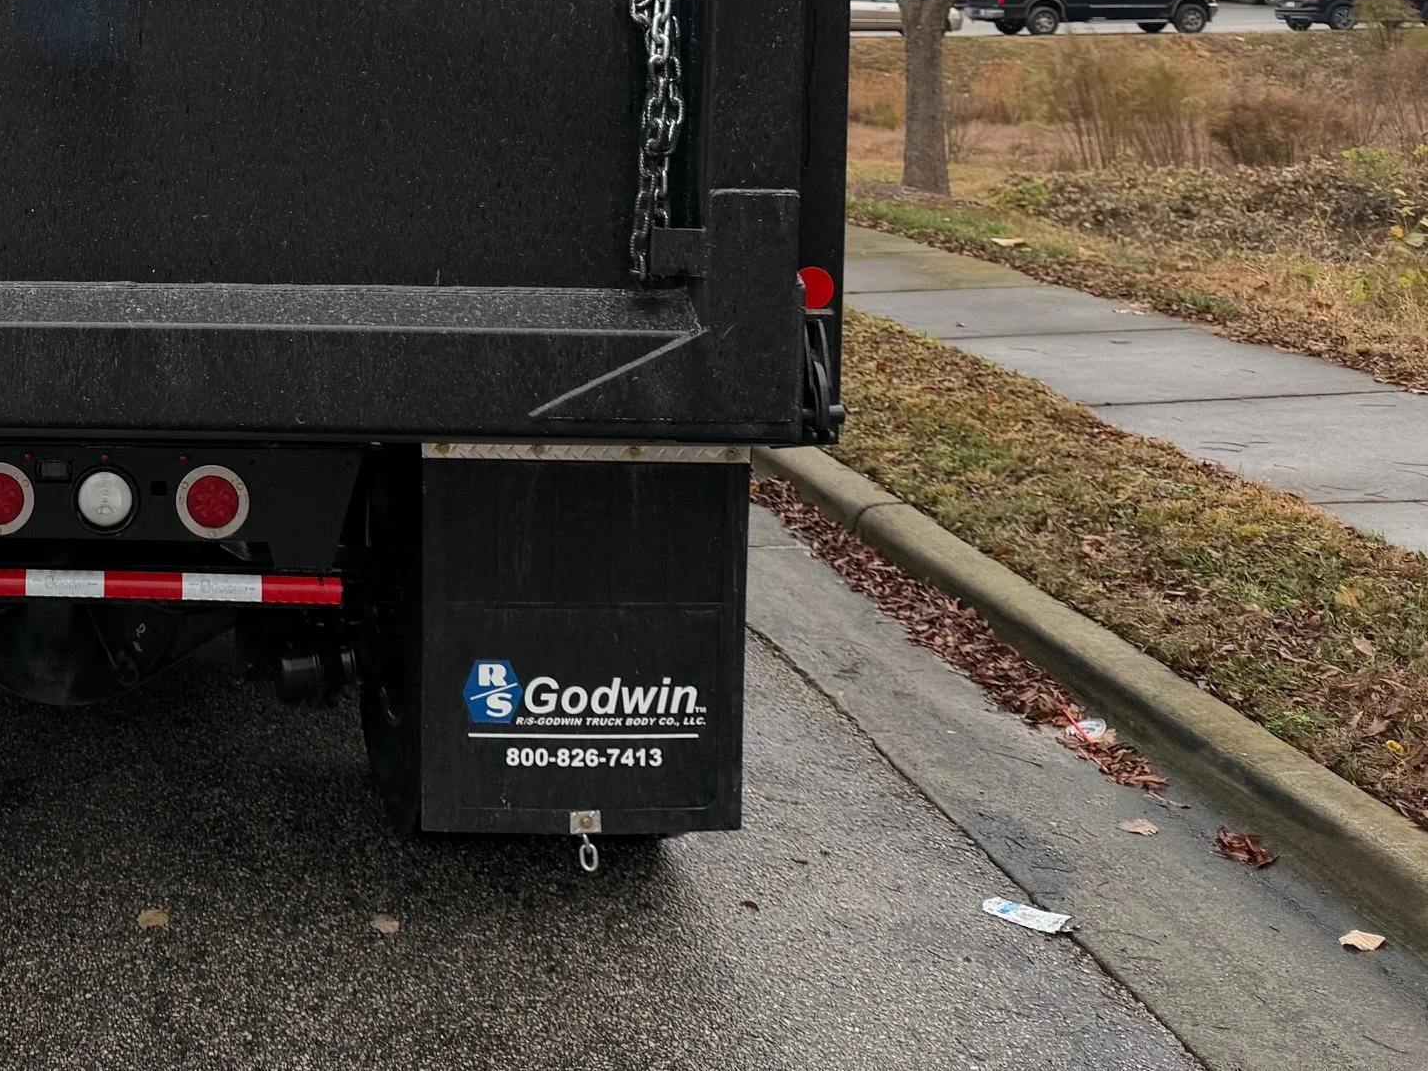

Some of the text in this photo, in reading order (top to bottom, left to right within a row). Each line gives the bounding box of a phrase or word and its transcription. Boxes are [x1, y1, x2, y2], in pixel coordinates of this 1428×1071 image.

[524, 676, 698, 714] Godwin
[586, 717, 623, 726] TRUCK
[625, 717, 657, 726] BODY
[505, 747, 663, 767] 800-826-7413
